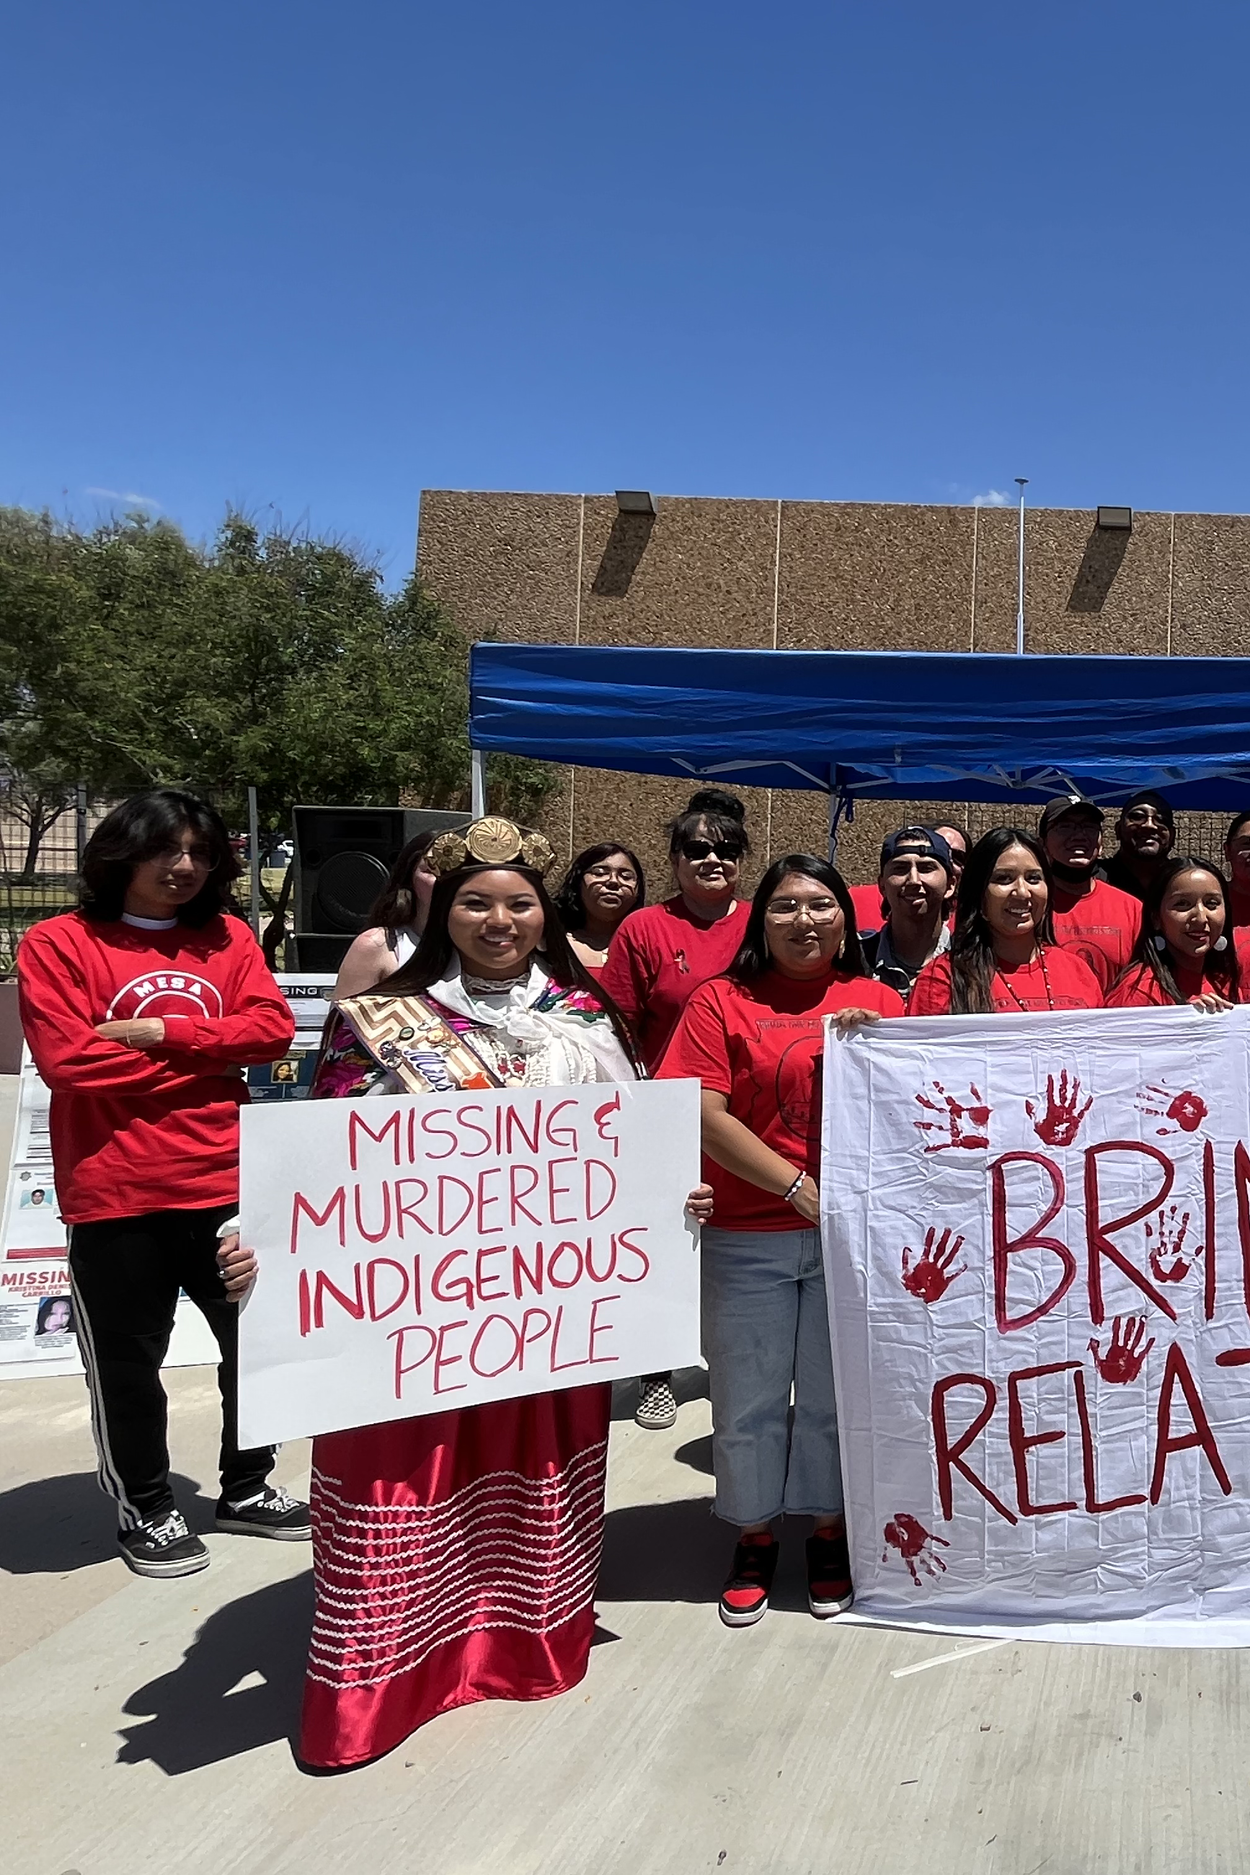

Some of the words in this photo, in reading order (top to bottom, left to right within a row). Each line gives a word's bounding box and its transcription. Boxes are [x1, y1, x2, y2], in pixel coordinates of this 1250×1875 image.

[132, 976, 202, 998] MESA
[280, 987, 318, 996] SING
[402, 1047, 456, 1092] Miss
[349, 1098, 579, 1171] MISSING
[593, 1090, 621, 1158] &
[290, 1156, 618, 1255] MURDERED
[1, 1270, 71, 1286] MISSIN
[299, 1226, 650, 1338] INDIGENOUS
[386, 1294, 621, 1400] PEOPLE
